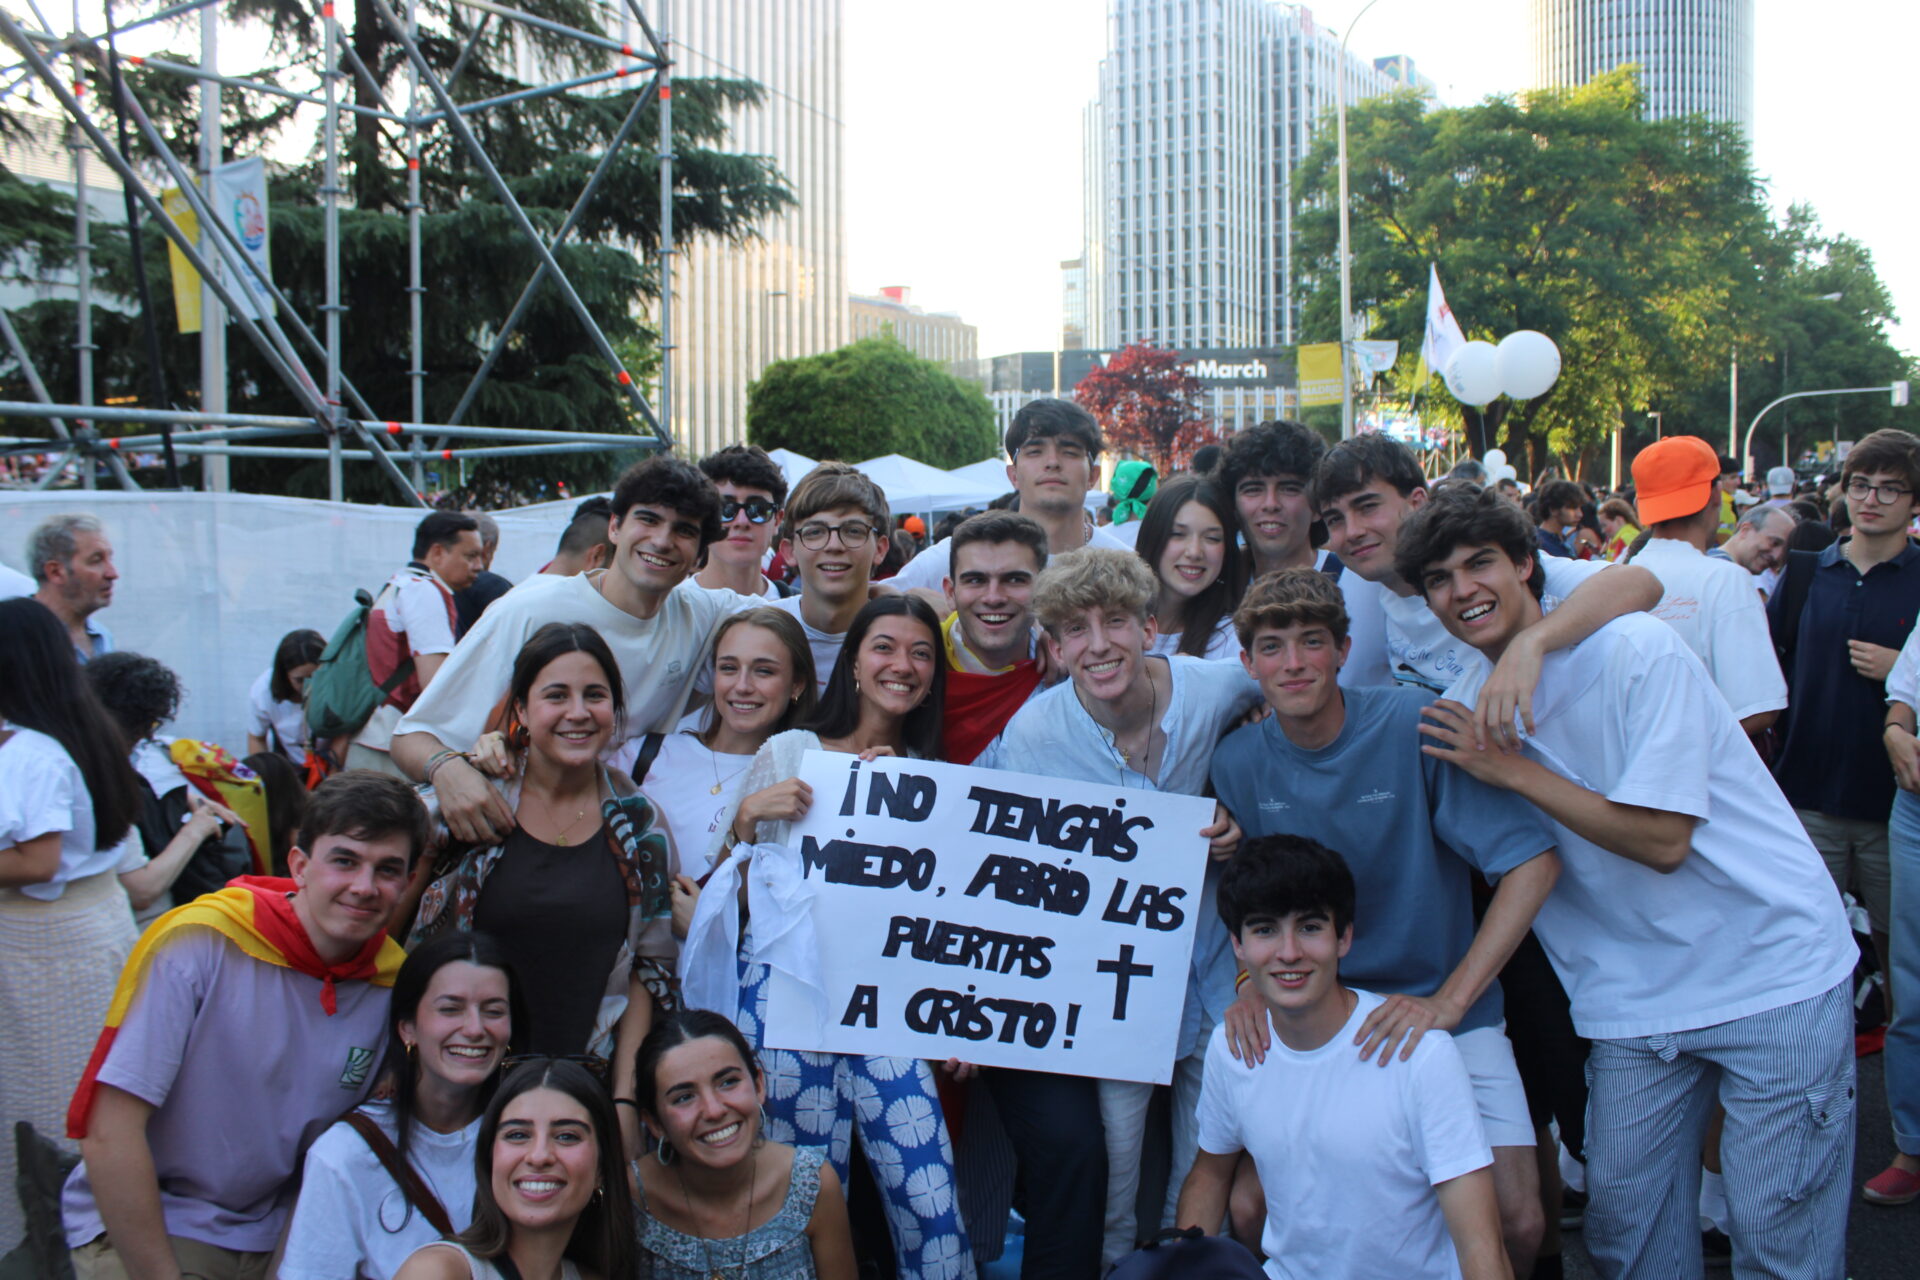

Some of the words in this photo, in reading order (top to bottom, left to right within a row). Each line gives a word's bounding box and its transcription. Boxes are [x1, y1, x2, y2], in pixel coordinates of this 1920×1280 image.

[801, 828, 946, 898] MIEDO,
[1101, 877, 1188, 932] LAS
[881, 915, 1056, 980] PUERTAS
[840, 984, 879, 1029] A
[904, 984, 1082, 1050] CRISTO!
